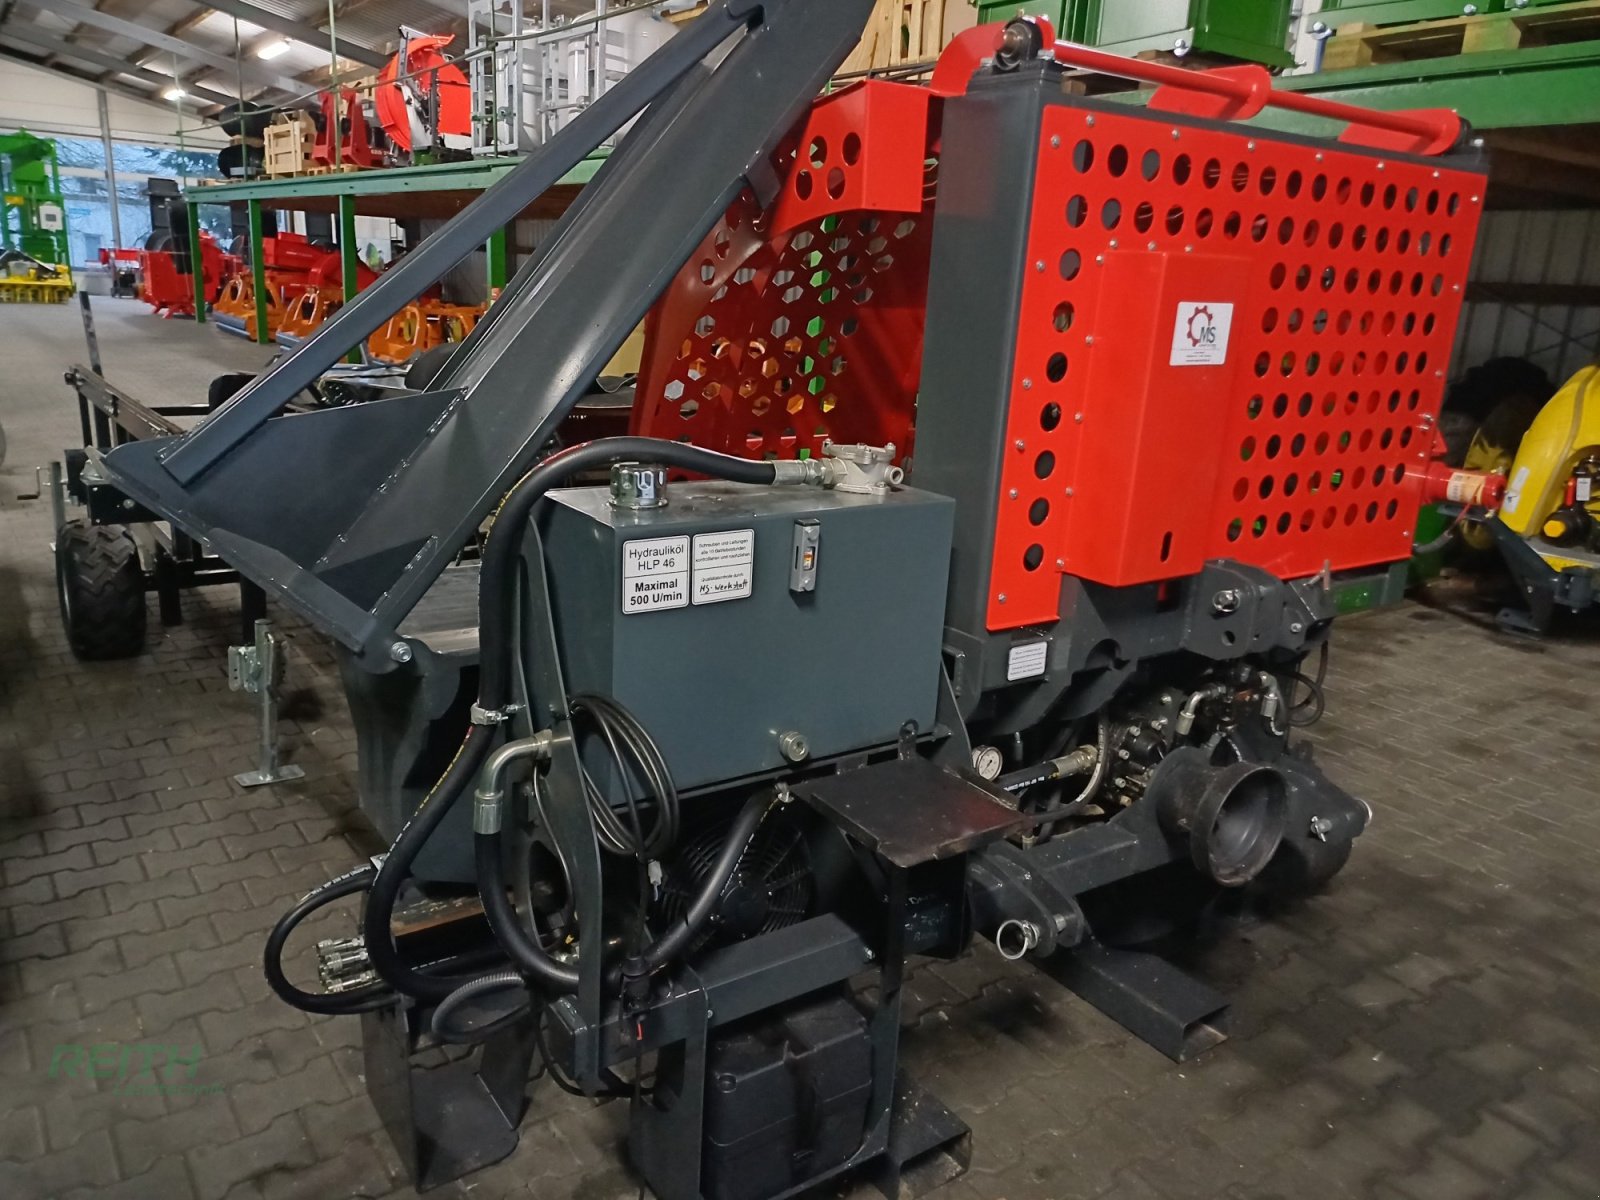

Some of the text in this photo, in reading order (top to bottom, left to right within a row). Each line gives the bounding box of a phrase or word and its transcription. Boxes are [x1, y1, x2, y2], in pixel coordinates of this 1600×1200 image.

[629, 544, 684, 560] Hydrauliköl
[638, 557, 675, 571] HLP 46
[635, 578, 678, 592] Maximal
[630, 591, 682, 606] 500 U/min
